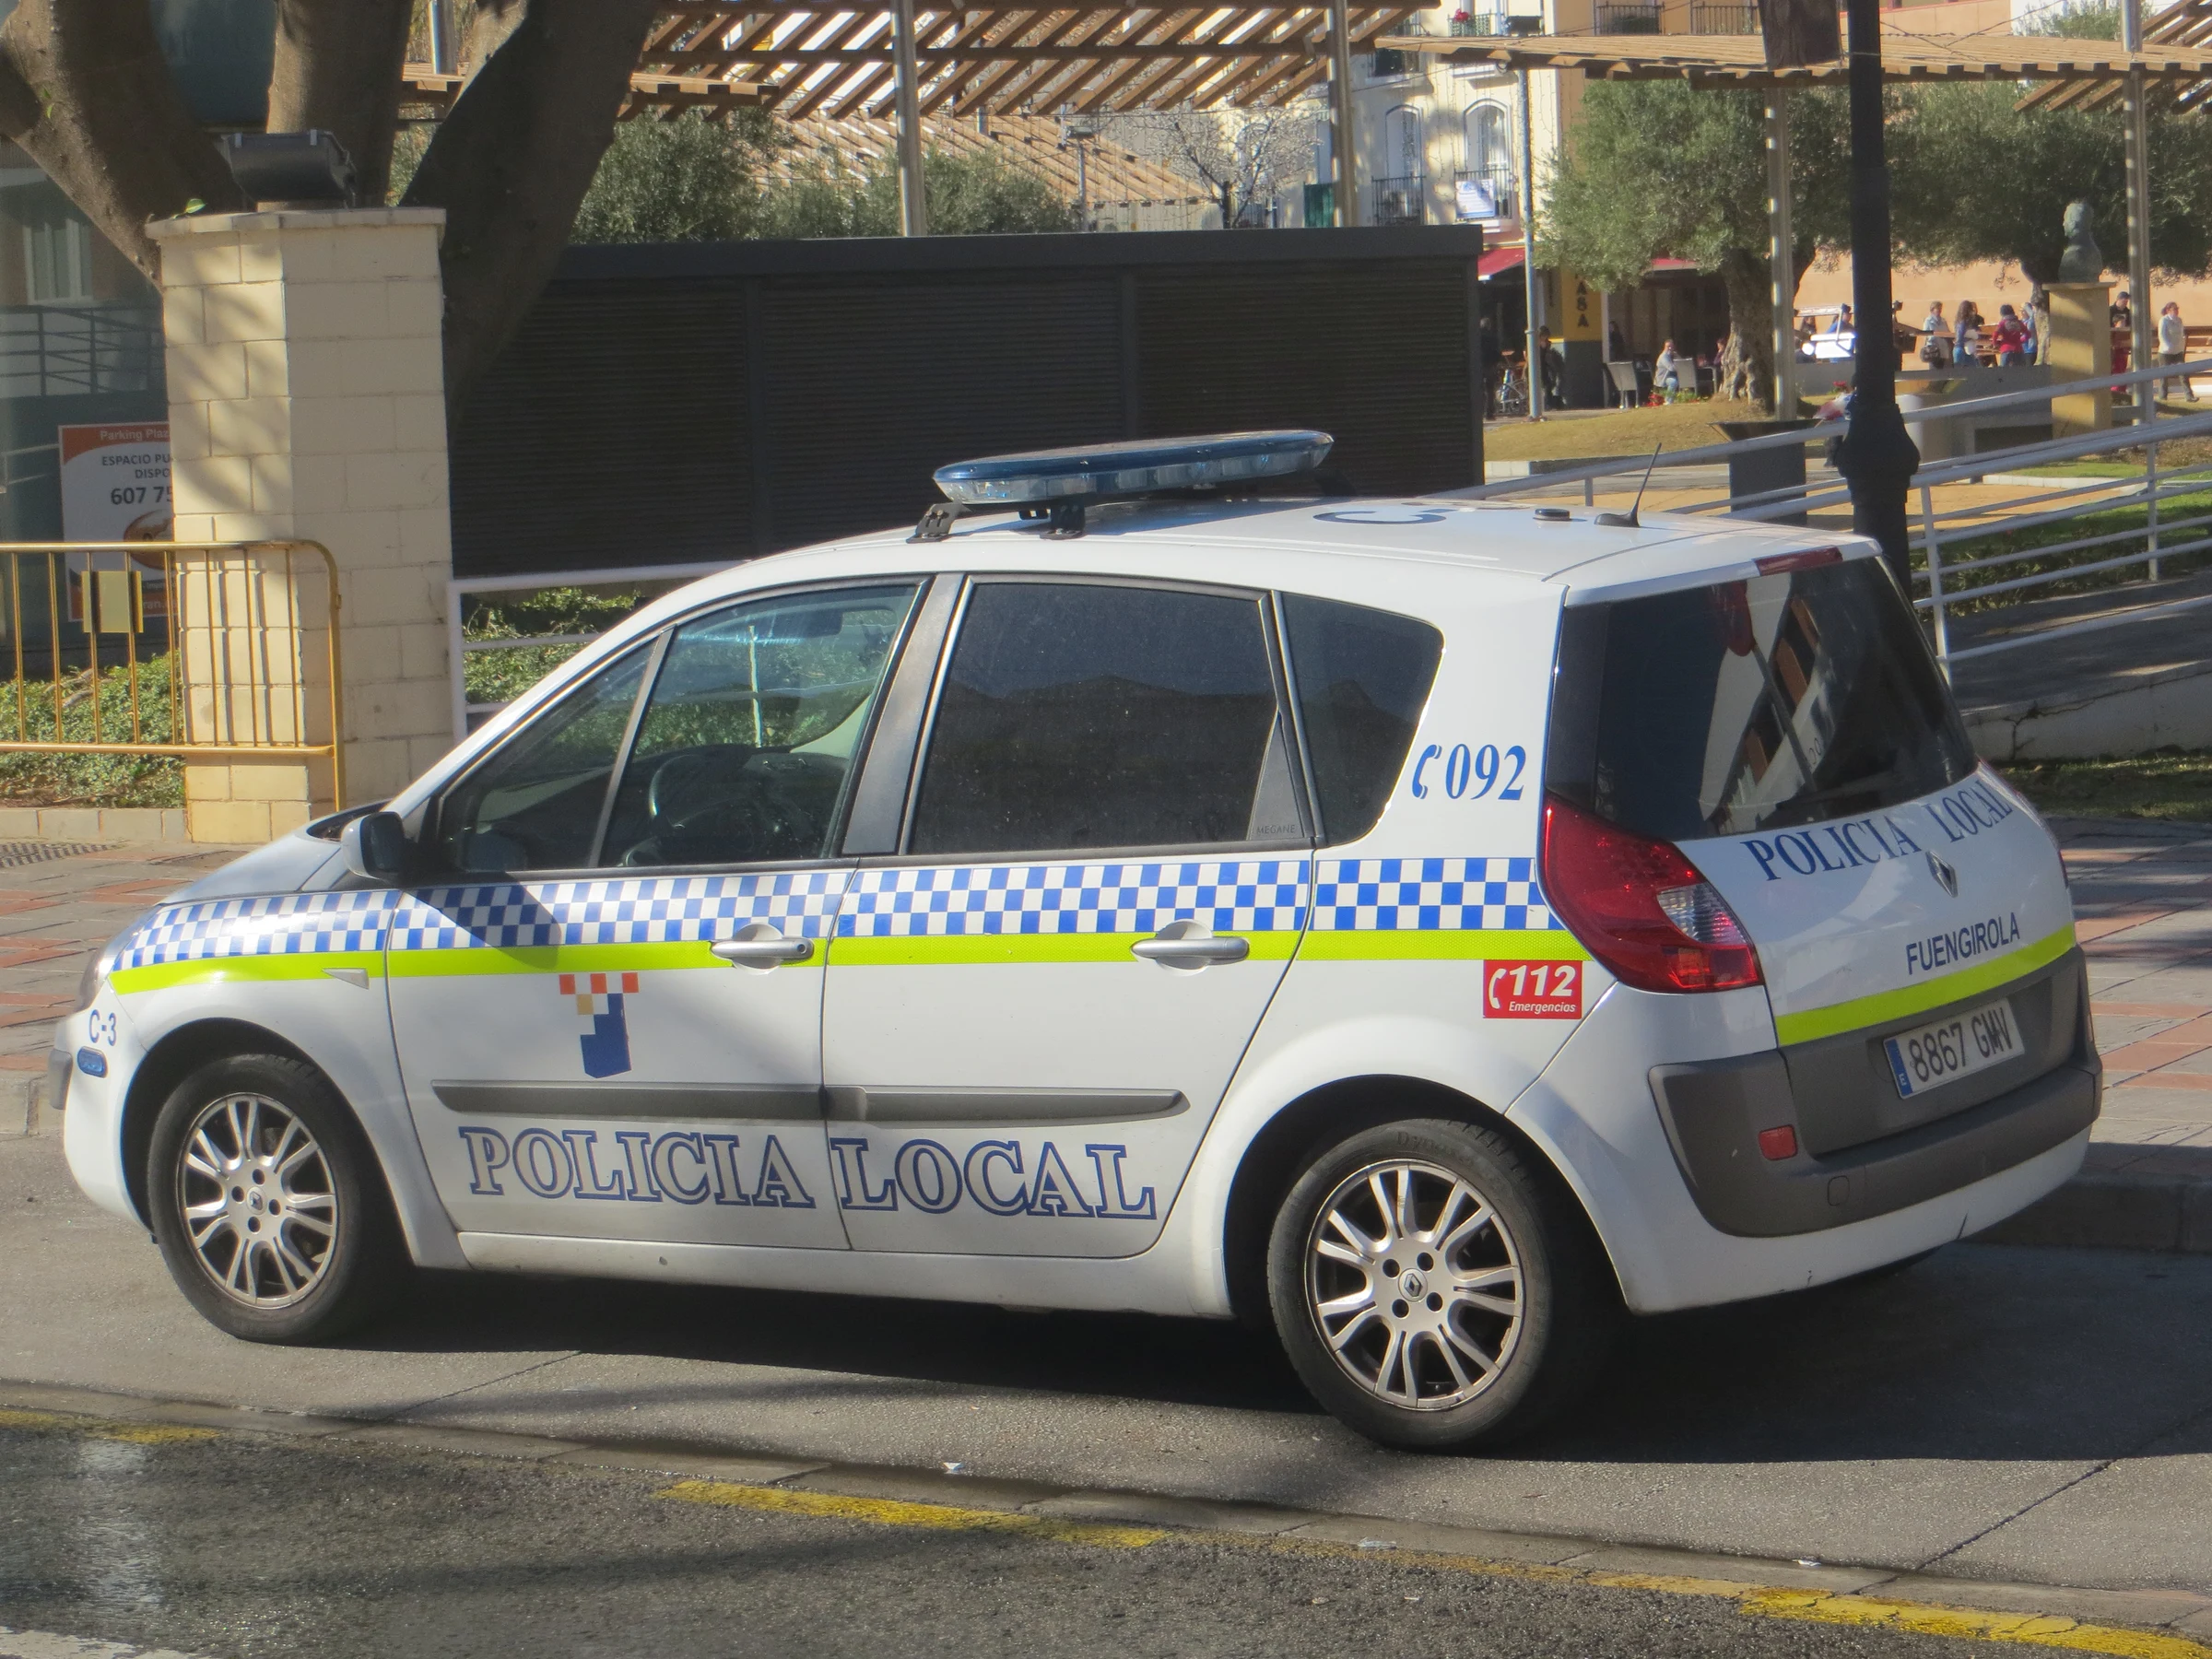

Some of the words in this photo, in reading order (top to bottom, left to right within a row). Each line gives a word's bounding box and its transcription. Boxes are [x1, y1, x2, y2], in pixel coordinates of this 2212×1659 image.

[100, 430, 143, 441] Parking
[101, 454, 151, 466] ESPACIO
[111, 487, 147, 505] 607
[1444, 743, 1527, 802] 092
[1256, 825, 1296, 835] MEGANE
[1739, 815, 1922, 881] POLICIA
[1923, 779, 2013, 842] LOCAL
[1905, 912, 2021, 975] FUENGIROLA
[1509, 964, 1577, 997] 112
[1509, 1001, 1577, 1015] Emergencias
[88, 1008, 117, 1047] C-3
[1908, 1022, 1967, 1083] 8867
[1971, 1007, 2013, 1058] GMV
[457, 1126, 817, 1209] POLICIA
[830, 1136, 1157, 1220] LOCAL
